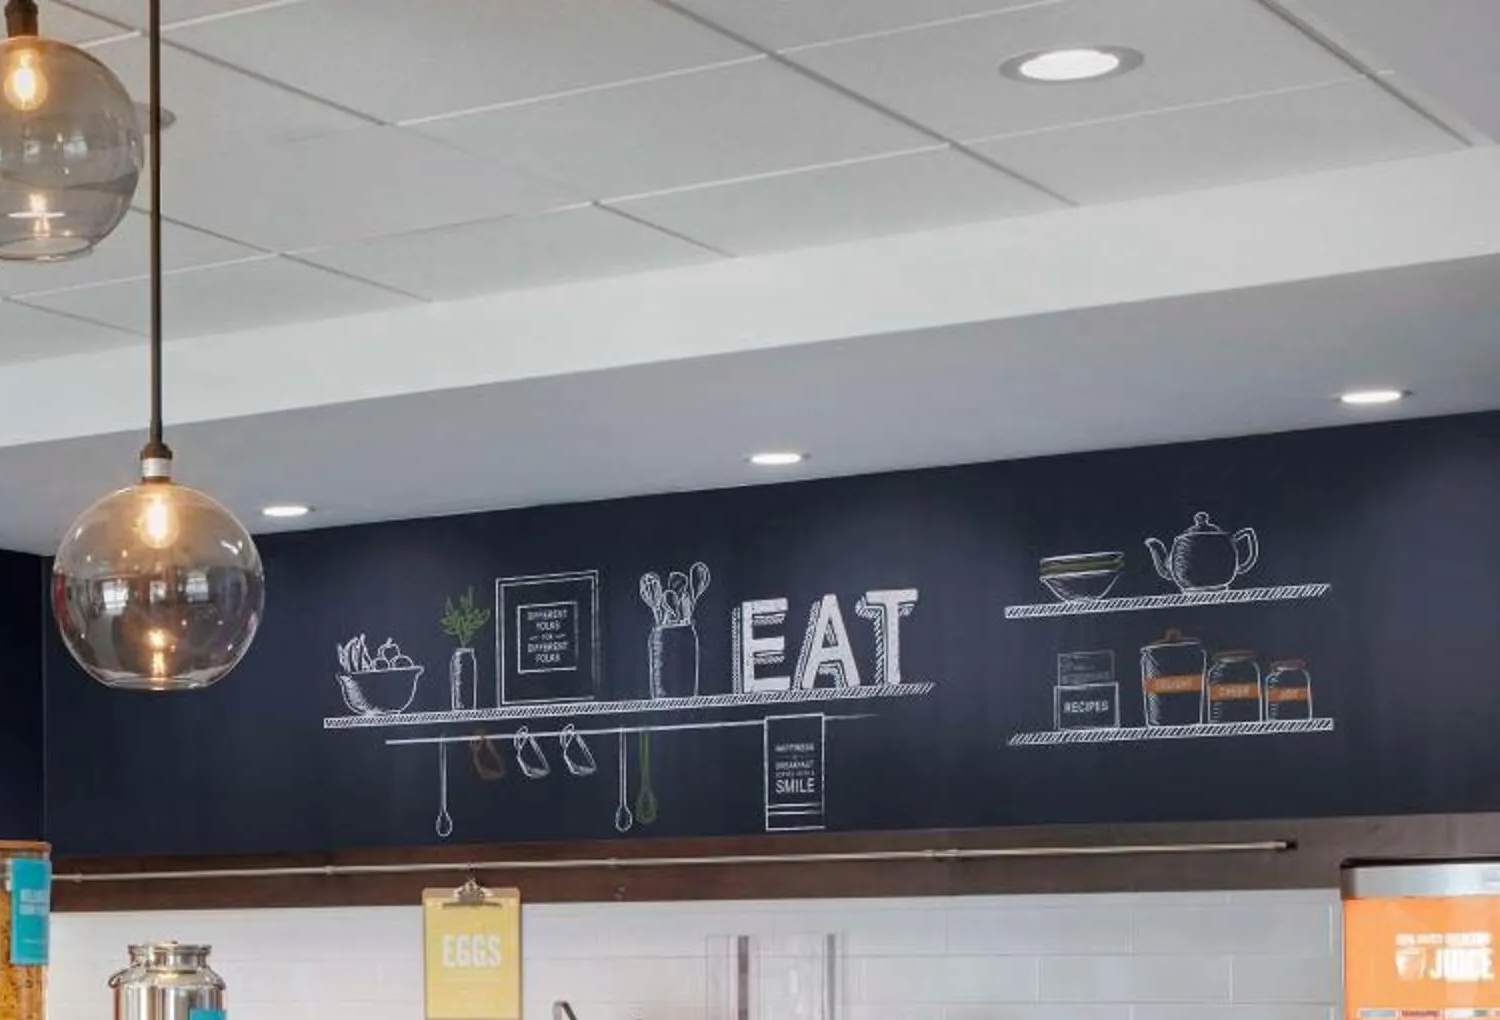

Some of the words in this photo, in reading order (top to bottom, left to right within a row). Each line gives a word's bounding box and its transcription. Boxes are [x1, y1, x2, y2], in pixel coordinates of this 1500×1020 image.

[731, 588, 919, 694] EAT
[775, 777, 815, 794] SMILE
[442, 932, 501, 968] EGGS
